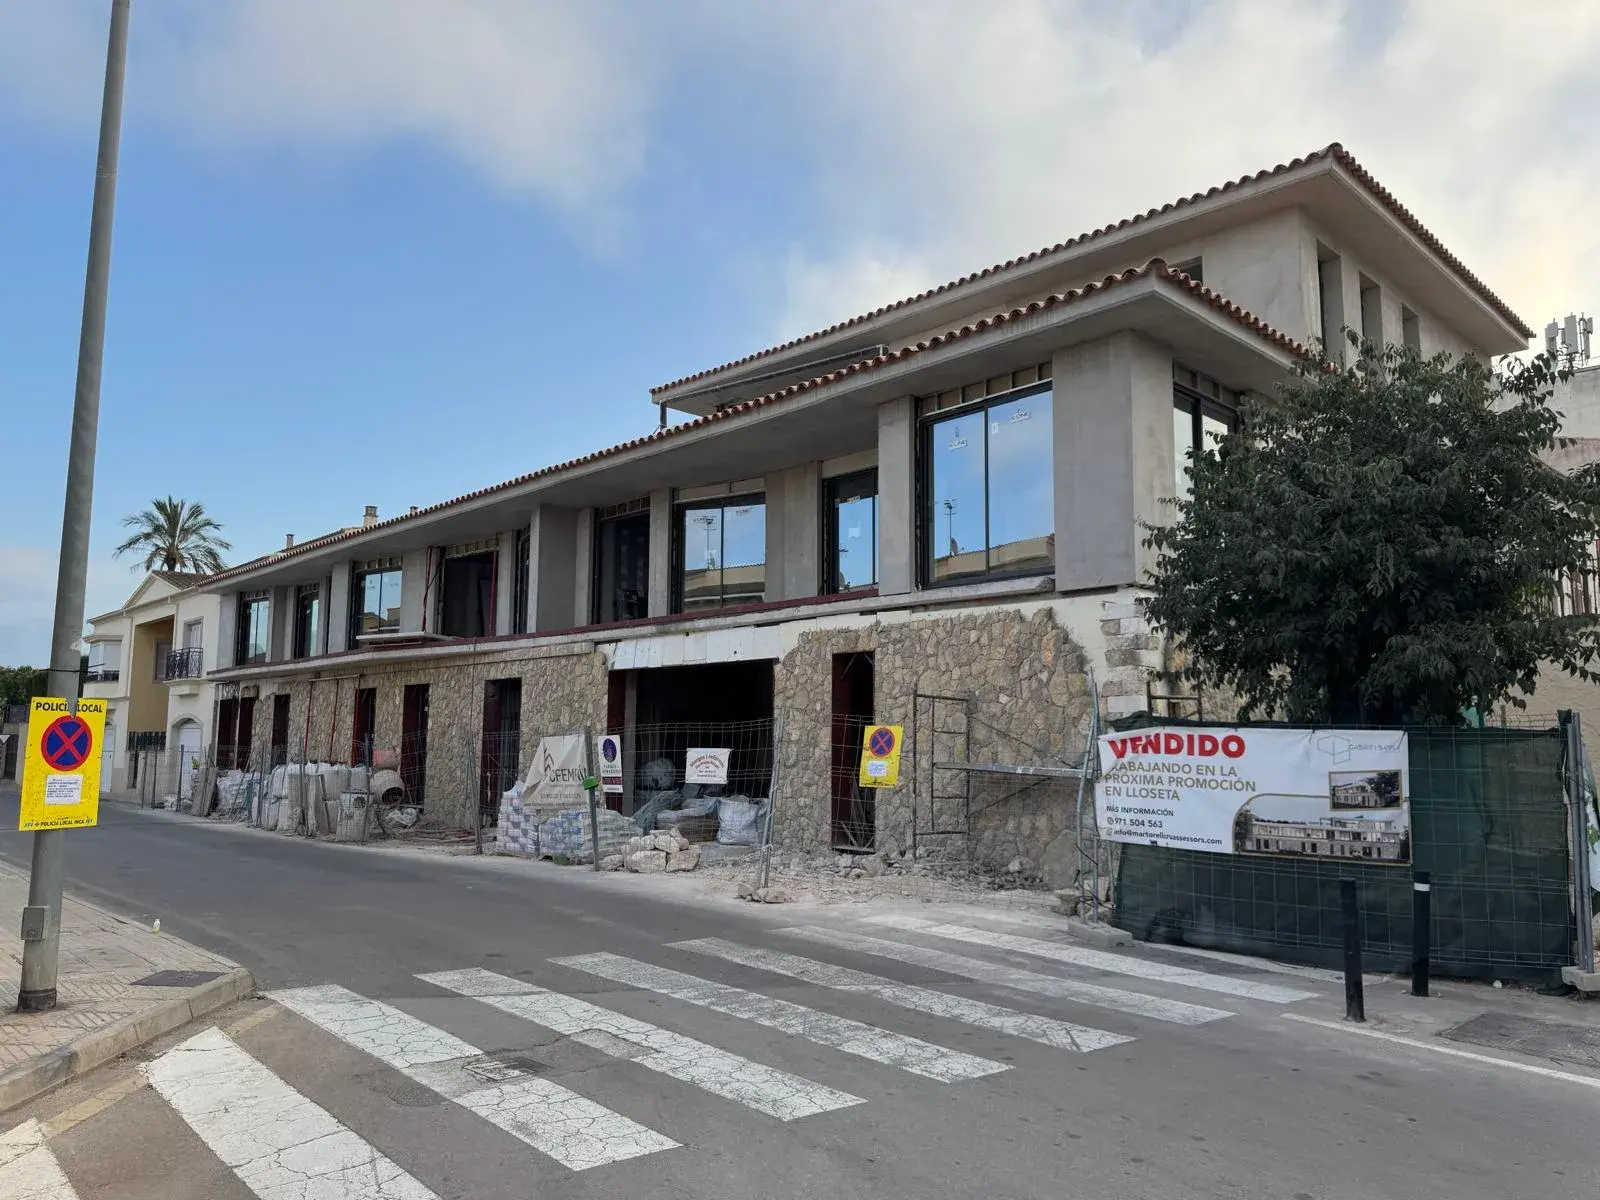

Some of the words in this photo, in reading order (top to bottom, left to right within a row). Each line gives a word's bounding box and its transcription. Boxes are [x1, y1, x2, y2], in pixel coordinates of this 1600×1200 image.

[35, 702, 69, 711] POLICI
[77, 703, 103, 713] LOCAL
[1107, 732, 1246, 759] VENDIDO
[1112, 761, 1192, 774] ABAJANDO
[1196, 764, 1215, 776] EN
[1220, 765, 1238, 777] LA
[1104, 771, 1164, 786] PRÓXIMA
[1168, 776, 1256, 792] PROMOCIÓN
[1105, 786, 1122, 796] EN
[1126, 787, 1180, 801] LLOSETA
[1121, 806, 1174, 817] INFORMACIÓN
[1115, 817, 1127, 826] 971
[1130, 819, 1145, 827] 504
[1148, 820, 1163, 828] 563
